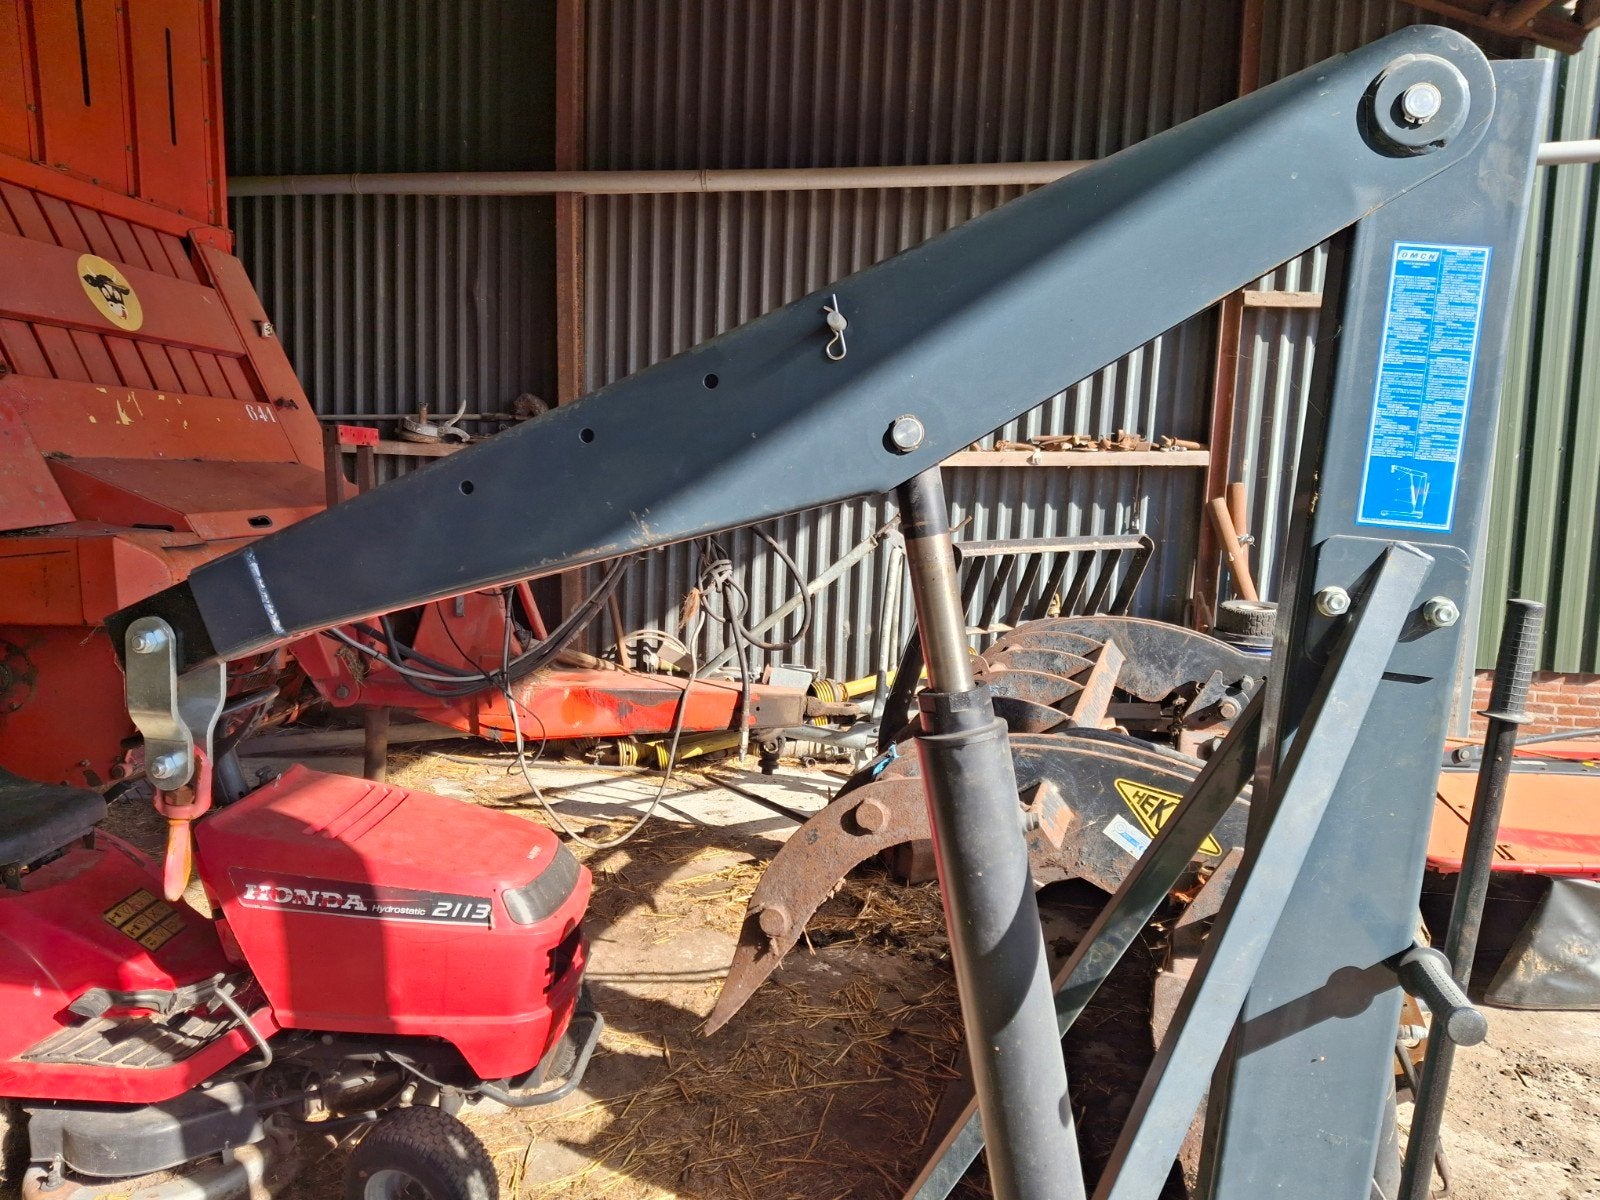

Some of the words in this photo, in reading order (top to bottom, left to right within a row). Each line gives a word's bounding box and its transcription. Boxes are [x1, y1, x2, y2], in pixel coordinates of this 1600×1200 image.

[243, 883, 368, 911] HONDA
[371, 904, 426, 916] Hydrostatic
[431, 901, 492, 919] 2113
